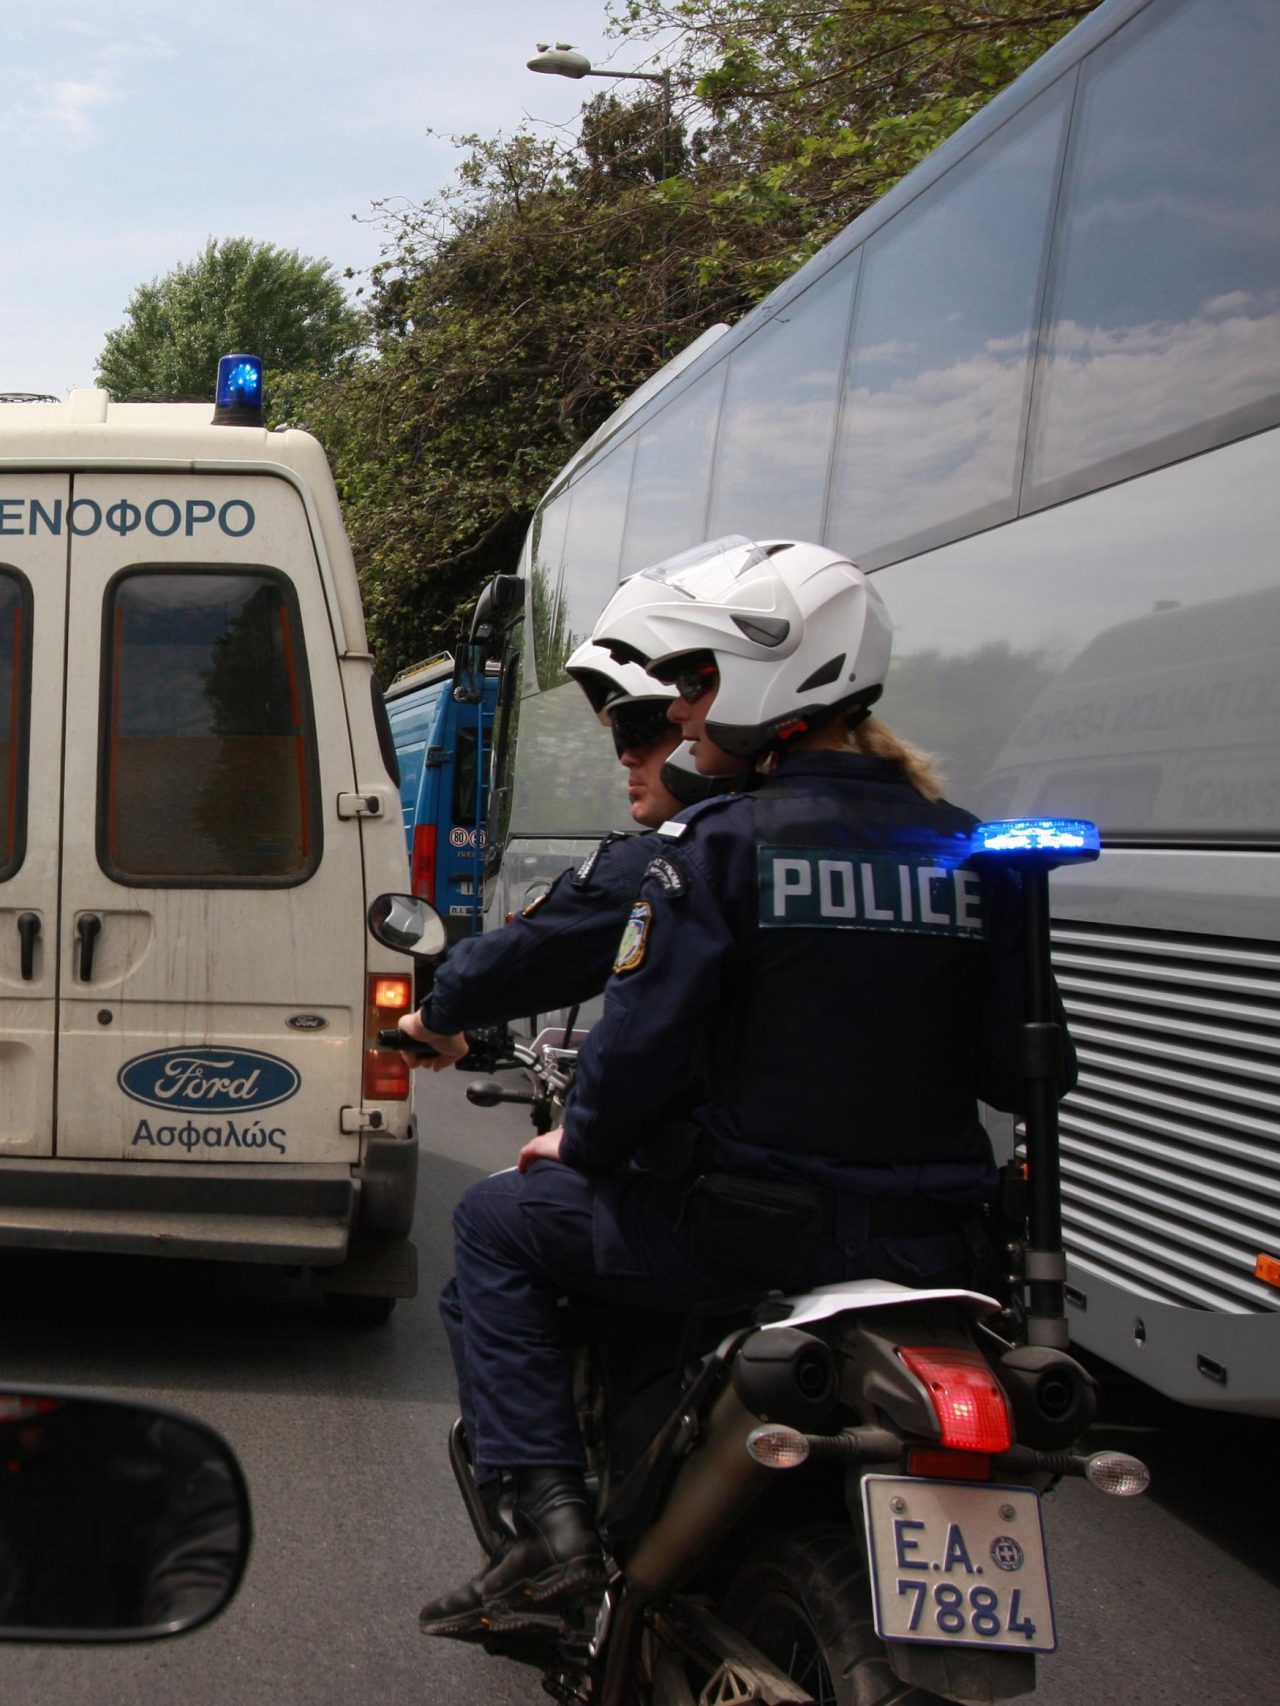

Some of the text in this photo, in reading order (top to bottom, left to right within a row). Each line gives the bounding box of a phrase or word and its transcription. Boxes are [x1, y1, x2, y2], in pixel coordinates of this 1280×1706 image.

[771, 857, 984, 930] POLICE
[295, 1015, 319, 1028] Ford
[153, 1057, 262, 1100] Ford
[131, 1119, 287, 1154] Ασφαλώς
[897, 1579, 1036, 1640] 7884
